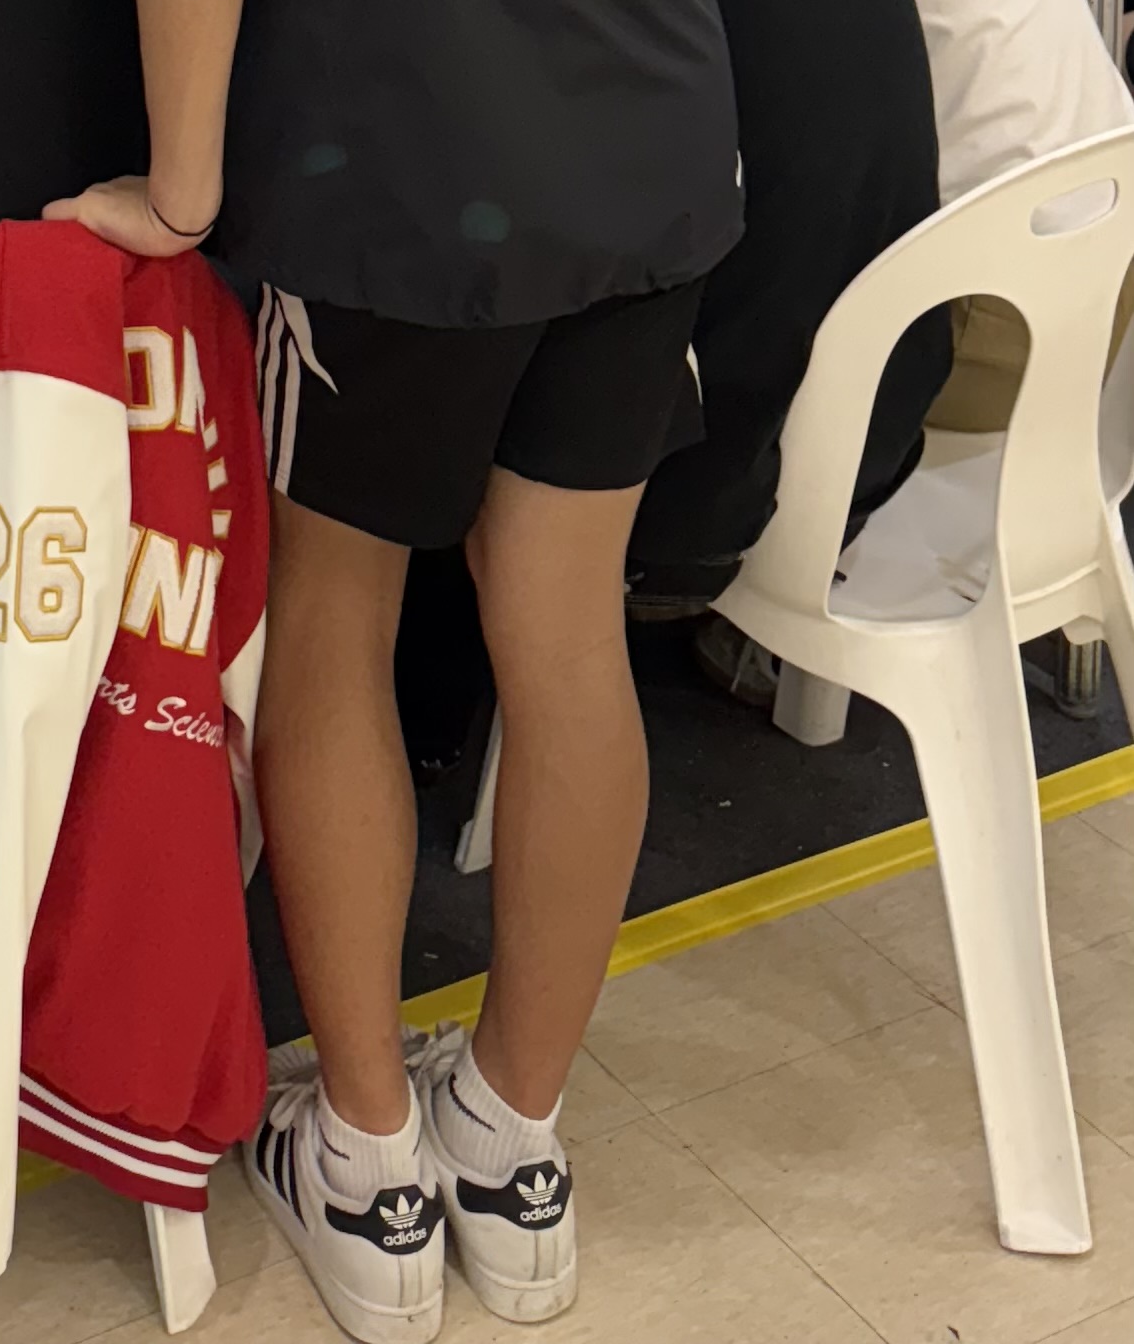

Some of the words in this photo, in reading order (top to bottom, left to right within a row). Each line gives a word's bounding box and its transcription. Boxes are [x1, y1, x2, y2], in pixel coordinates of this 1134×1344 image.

[97, 674, 137, 714] rts
[145, 696, 224, 749] Scien
[519, 1201, 563, 1223] adidas
[383, 1226, 427, 1247] adidas
